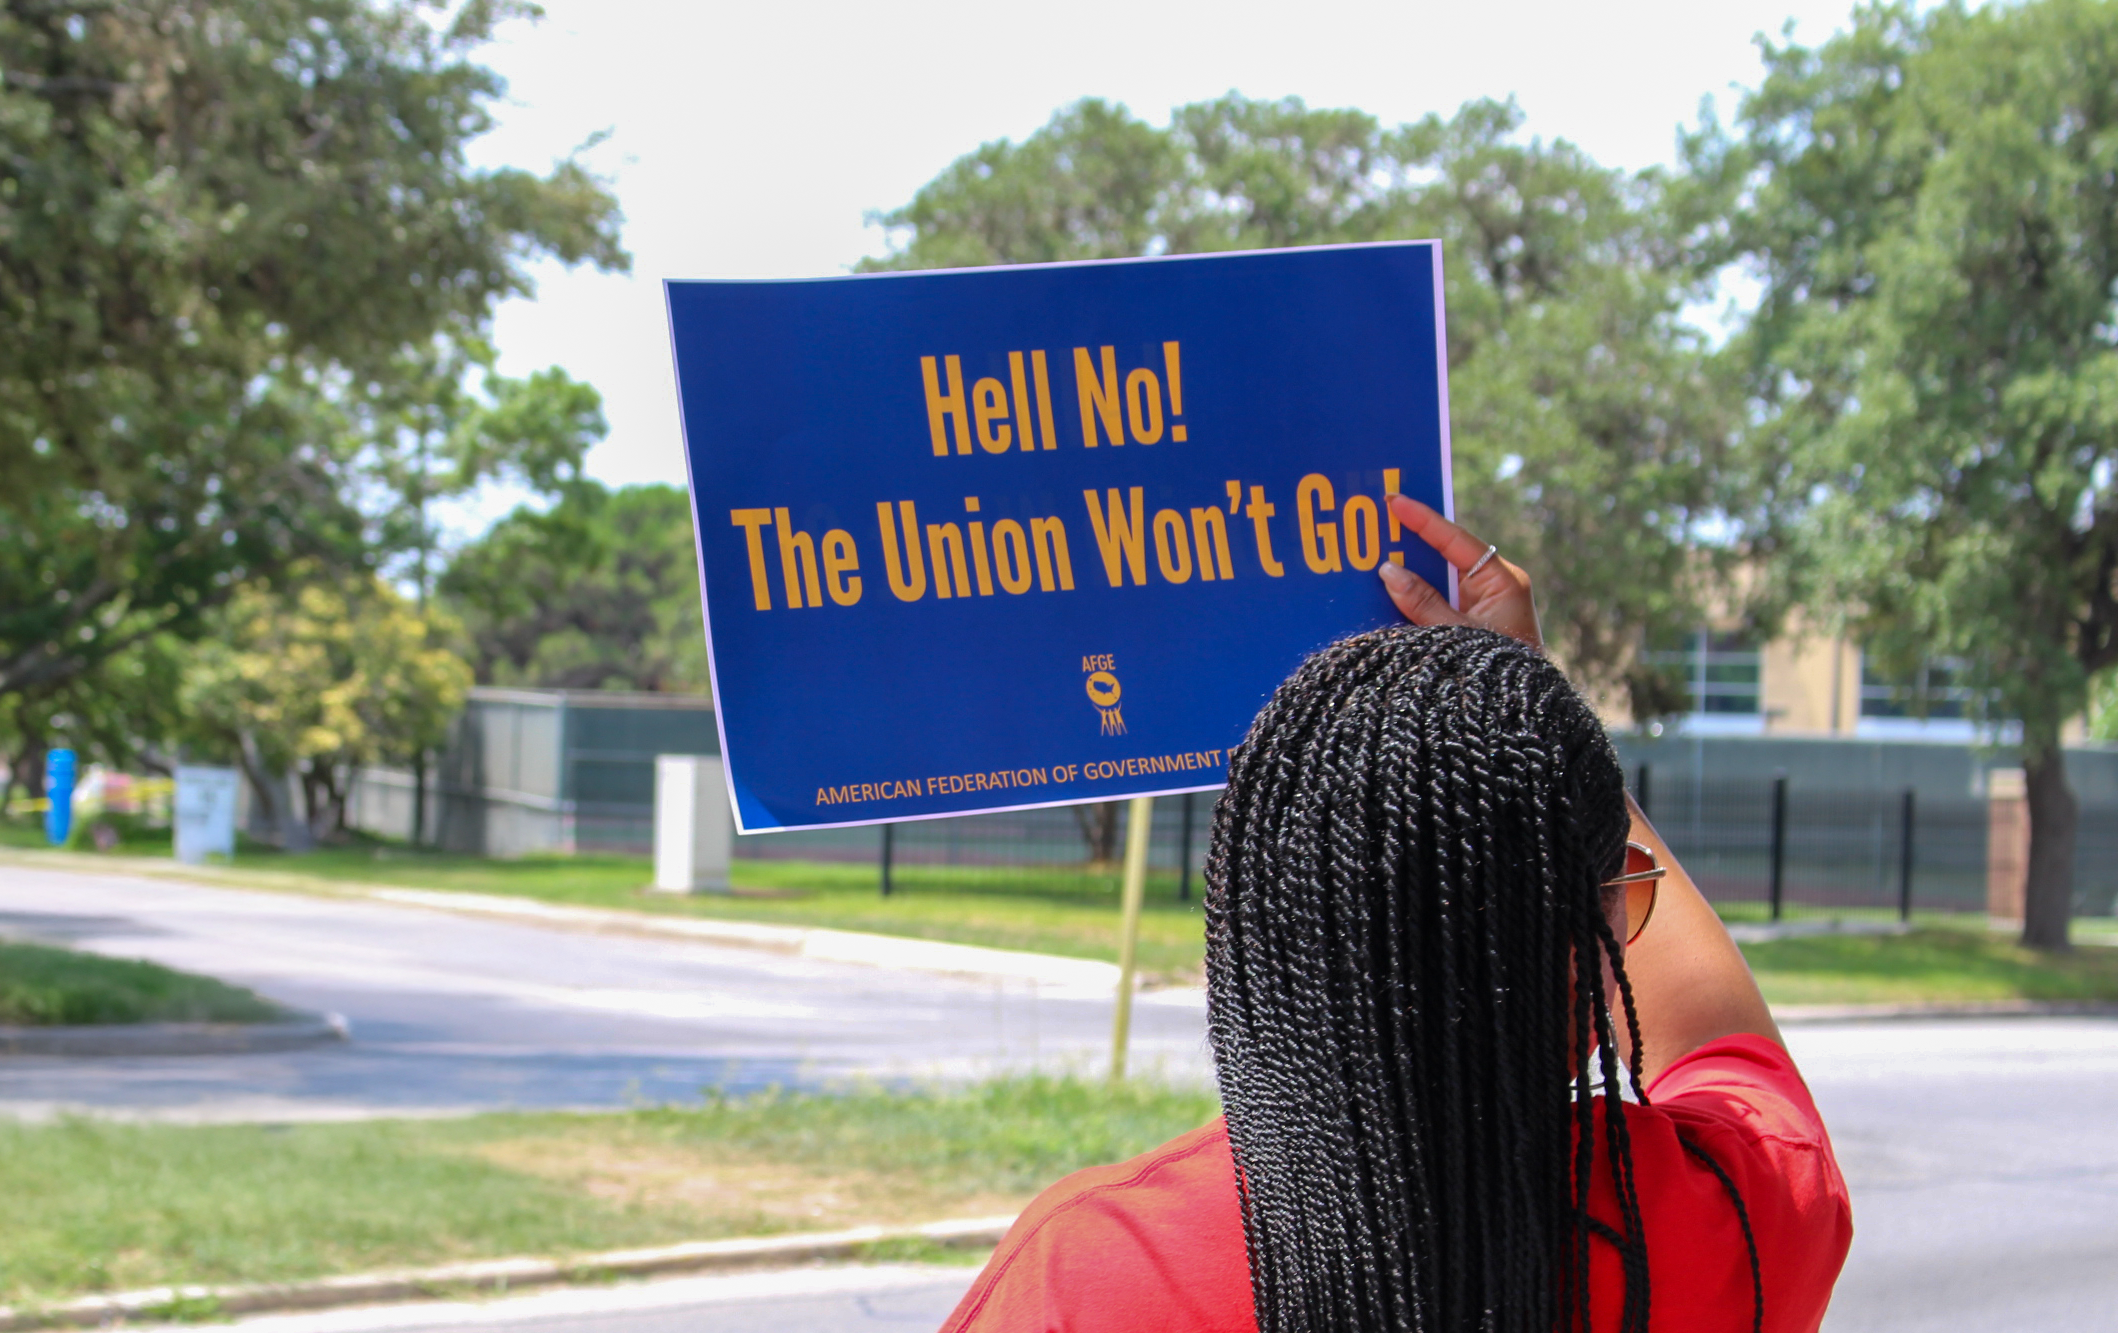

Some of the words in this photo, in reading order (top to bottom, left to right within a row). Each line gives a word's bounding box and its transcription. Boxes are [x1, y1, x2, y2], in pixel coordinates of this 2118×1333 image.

[919, 350, 1058, 456] Hell
[1073, 340, 1189, 448] No!
[729, 506, 863, 611] The
[876, 496, 1076, 603] Union
[1083, 479, 1285, 588] Won't
[1295, 467, 1406, 575] Go!
[1082, 653, 1117, 672] AFGE
[815, 779, 922, 805] AMERICAN
[926, 768, 1049, 795] FEDERATION
[1052, 763, 1079, 783] OF
[1083, 749, 1222, 780] GOVERNMENT
